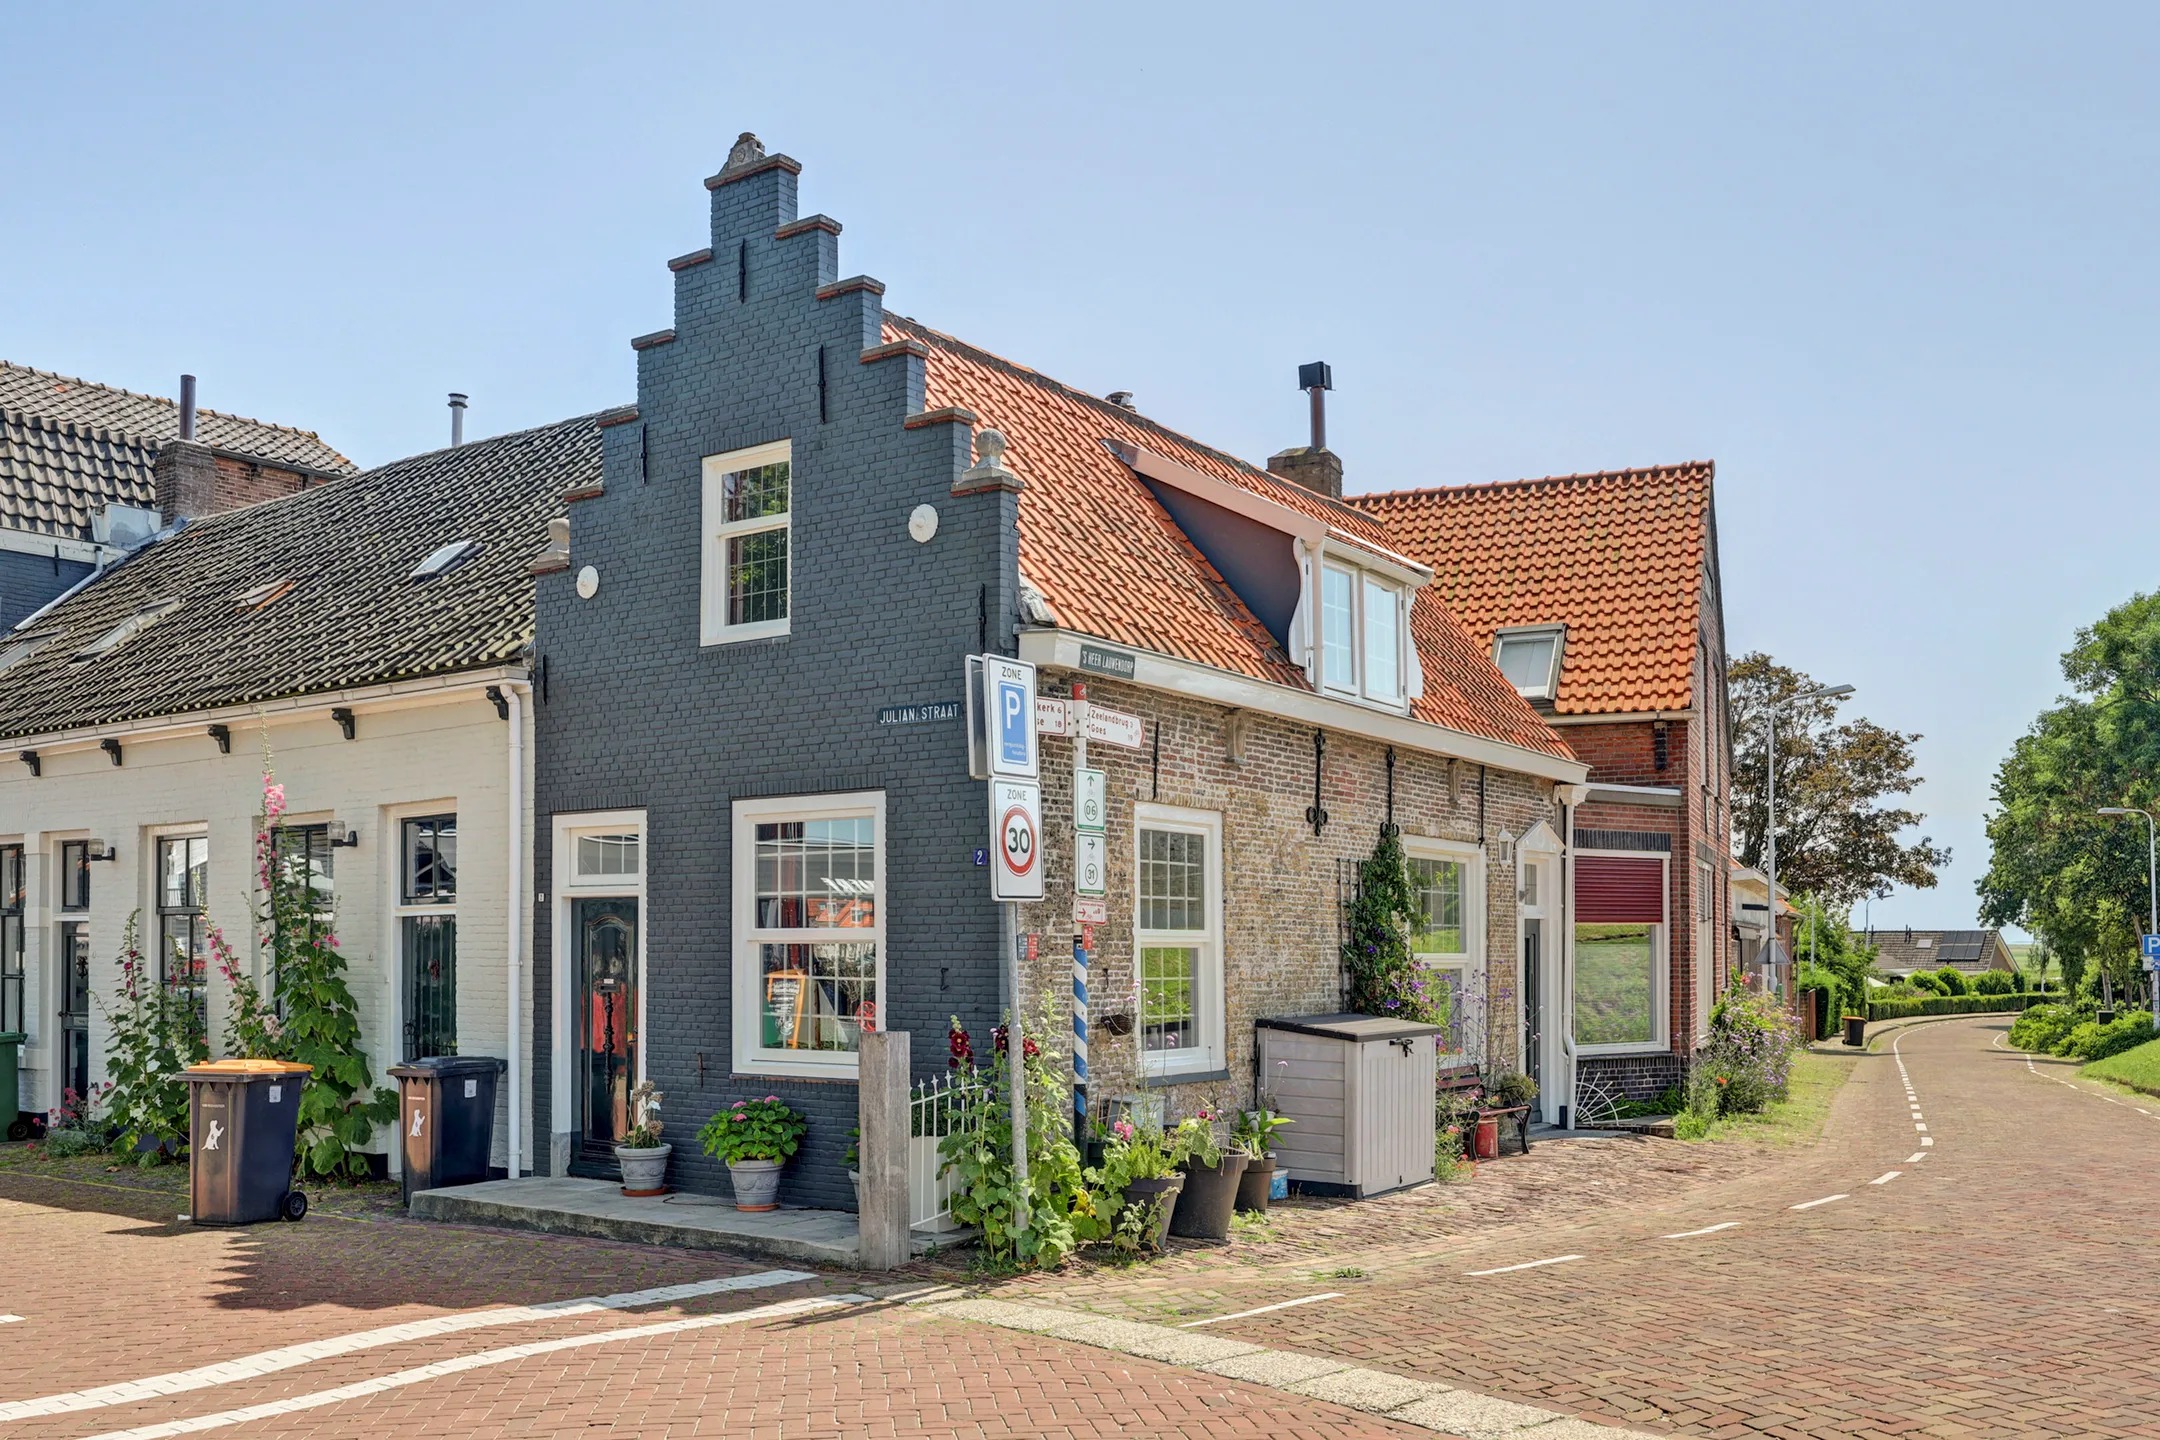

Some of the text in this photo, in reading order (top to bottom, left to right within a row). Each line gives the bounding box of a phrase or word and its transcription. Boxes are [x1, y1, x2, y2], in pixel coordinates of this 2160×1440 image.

[1087, 651, 1102, 667] HEER
[1002, 666, 1022, 680] ZONE
[921, 703, 958, 720] STRAAT
[1005, 690, 1021, 729] P
[1037, 702, 1062, 714] kerk 6
[1055, 720, 1062, 728] 18
[1091, 710, 1129, 729] Zeelandbrug
[1091, 723, 1107, 735] Goes
[1007, 789, 1027, 801] ZONE
[1086, 805, 1096, 816] 06
[1008, 827, 1030, 853] 30
[976, 849, 983, 865] 2
[1087, 869, 1095, 880] 31
